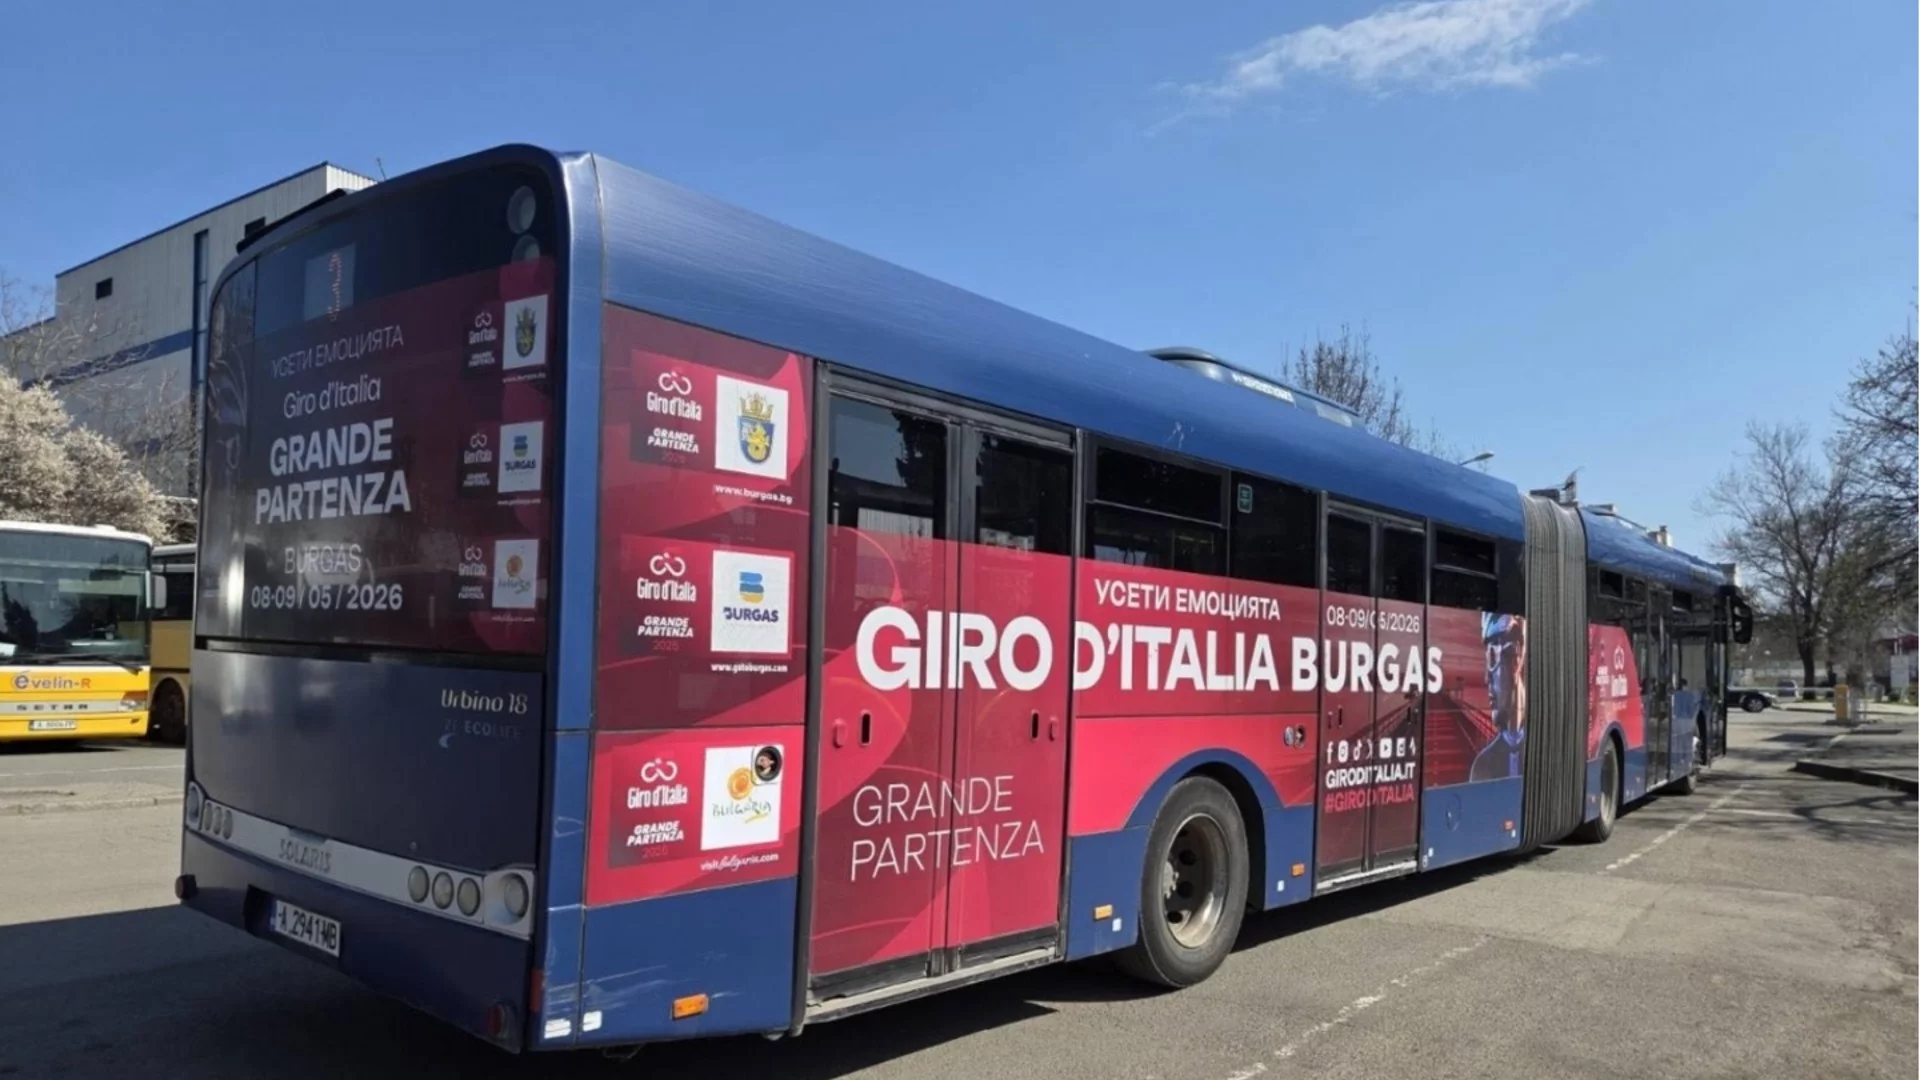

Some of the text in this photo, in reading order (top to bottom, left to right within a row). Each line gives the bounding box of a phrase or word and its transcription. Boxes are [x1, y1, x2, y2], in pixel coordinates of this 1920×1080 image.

[316, 325, 404, 368] ЕМОЦИЯТА
[283, 374, 381, 419] Giro d'Italia
[646, 391, 669, 415] Giro
[270, 417, 394, 477] GRANDE
[647, 435, 700, 455] PARTENZA
[652, 427, 696, 444] GRANDE
[256, 470, 412, 525] PARTENZA
[714, 484, 793, 505] www.burgas.bg
[284, 543, 362, 575] BURGAS
[637, 577, 660, 601] Giro
[1094, 578, 1281, 621] УСЕТИ ЕМОЦИЯТА
[643, 615, 690, 627] GRANDE
[723, 606, 779, 623] BURGAS
[637, 625, 695, 638] PARTENZA
[856, 605, 1443, 694] GIRO D'ITALIA BURGAS
[441, 689, 529, 715] Urbino 18
[627, 786, 651, 810] Giro
[853, 775, 1014, 827] GRANDE
[626, 829, 685, 847] PARTENZA
[633, 820, 680, 836] GRANDE
[278, 838, 332, 874] SOLARIS
[851, 820, 1044, 882] PARTENZA
